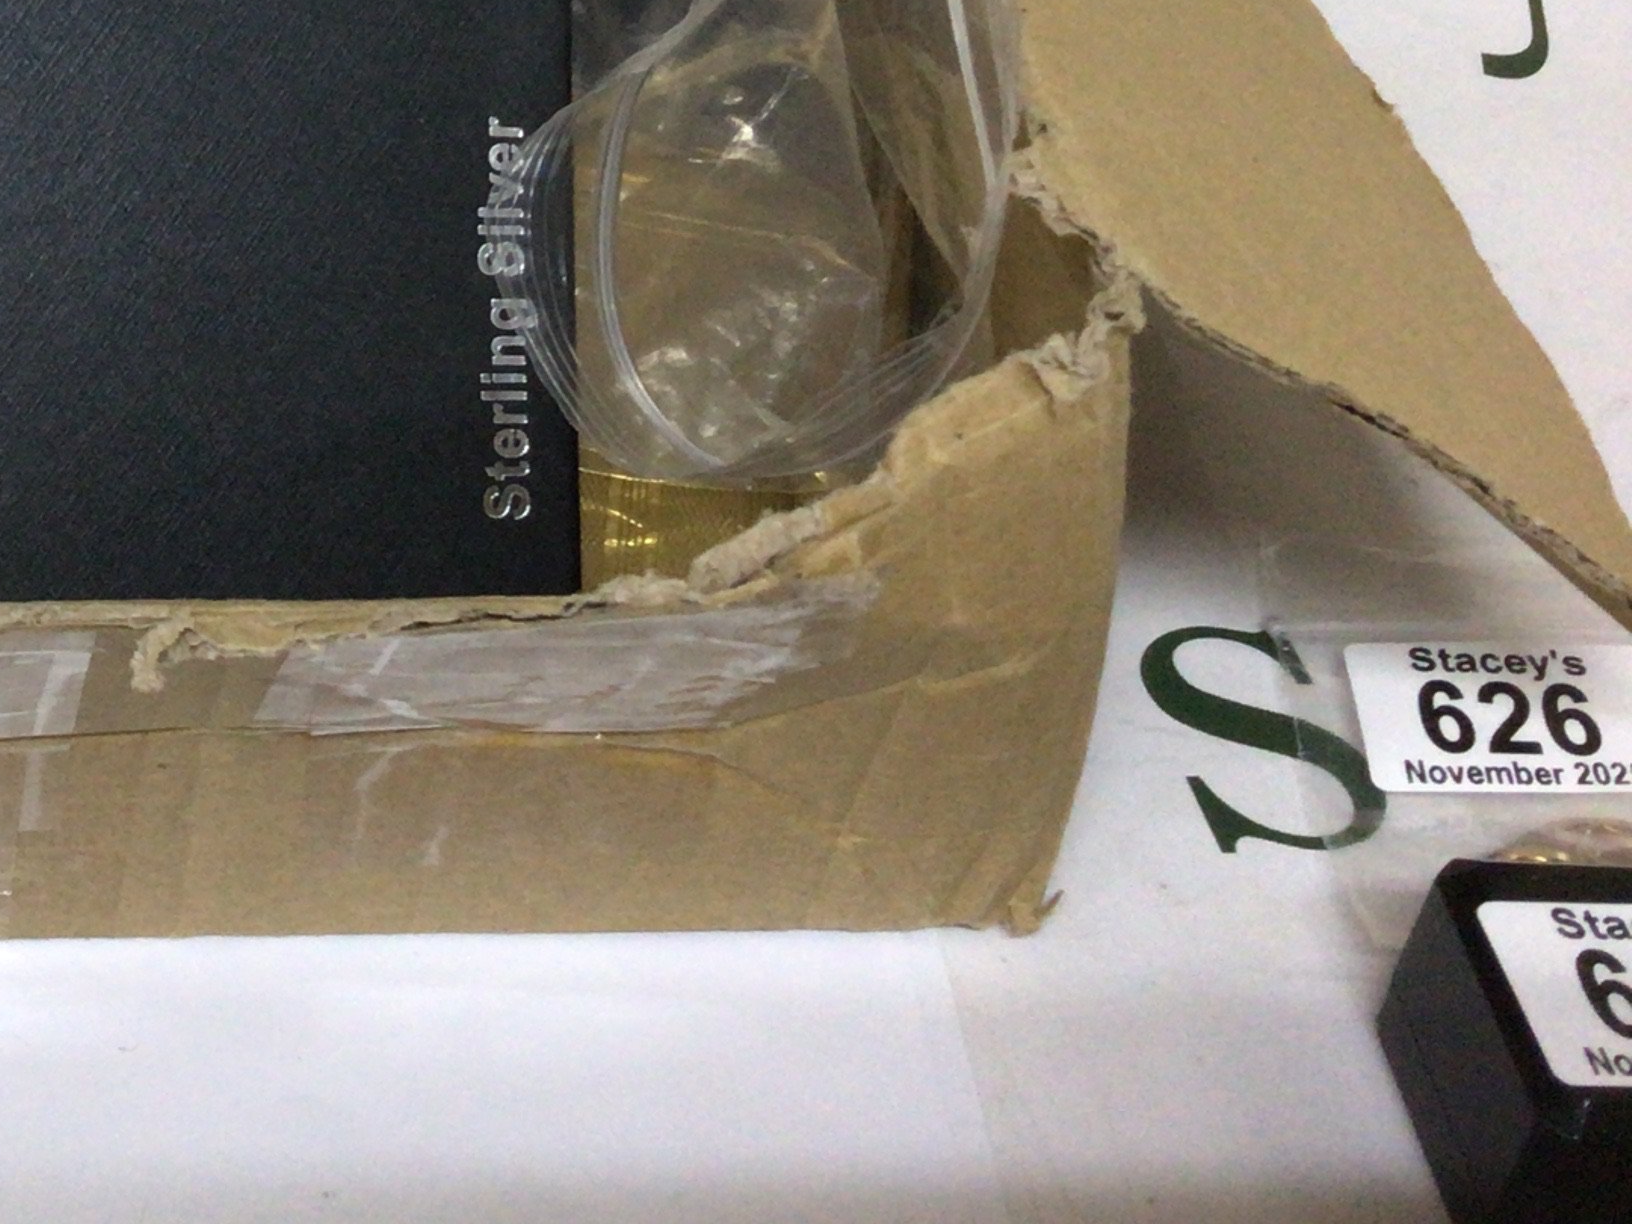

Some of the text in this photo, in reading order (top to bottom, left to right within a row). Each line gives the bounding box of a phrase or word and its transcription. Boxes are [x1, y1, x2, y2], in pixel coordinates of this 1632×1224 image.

[476, 115, 538, 521] Sterling Silver
[1408, 646, 1587, 682] Stacey's
[1418, 679, 1602, 757] 626
[1404, 759, 1632, 786] November 202
[1551, 907, 1632, 941] Sta
